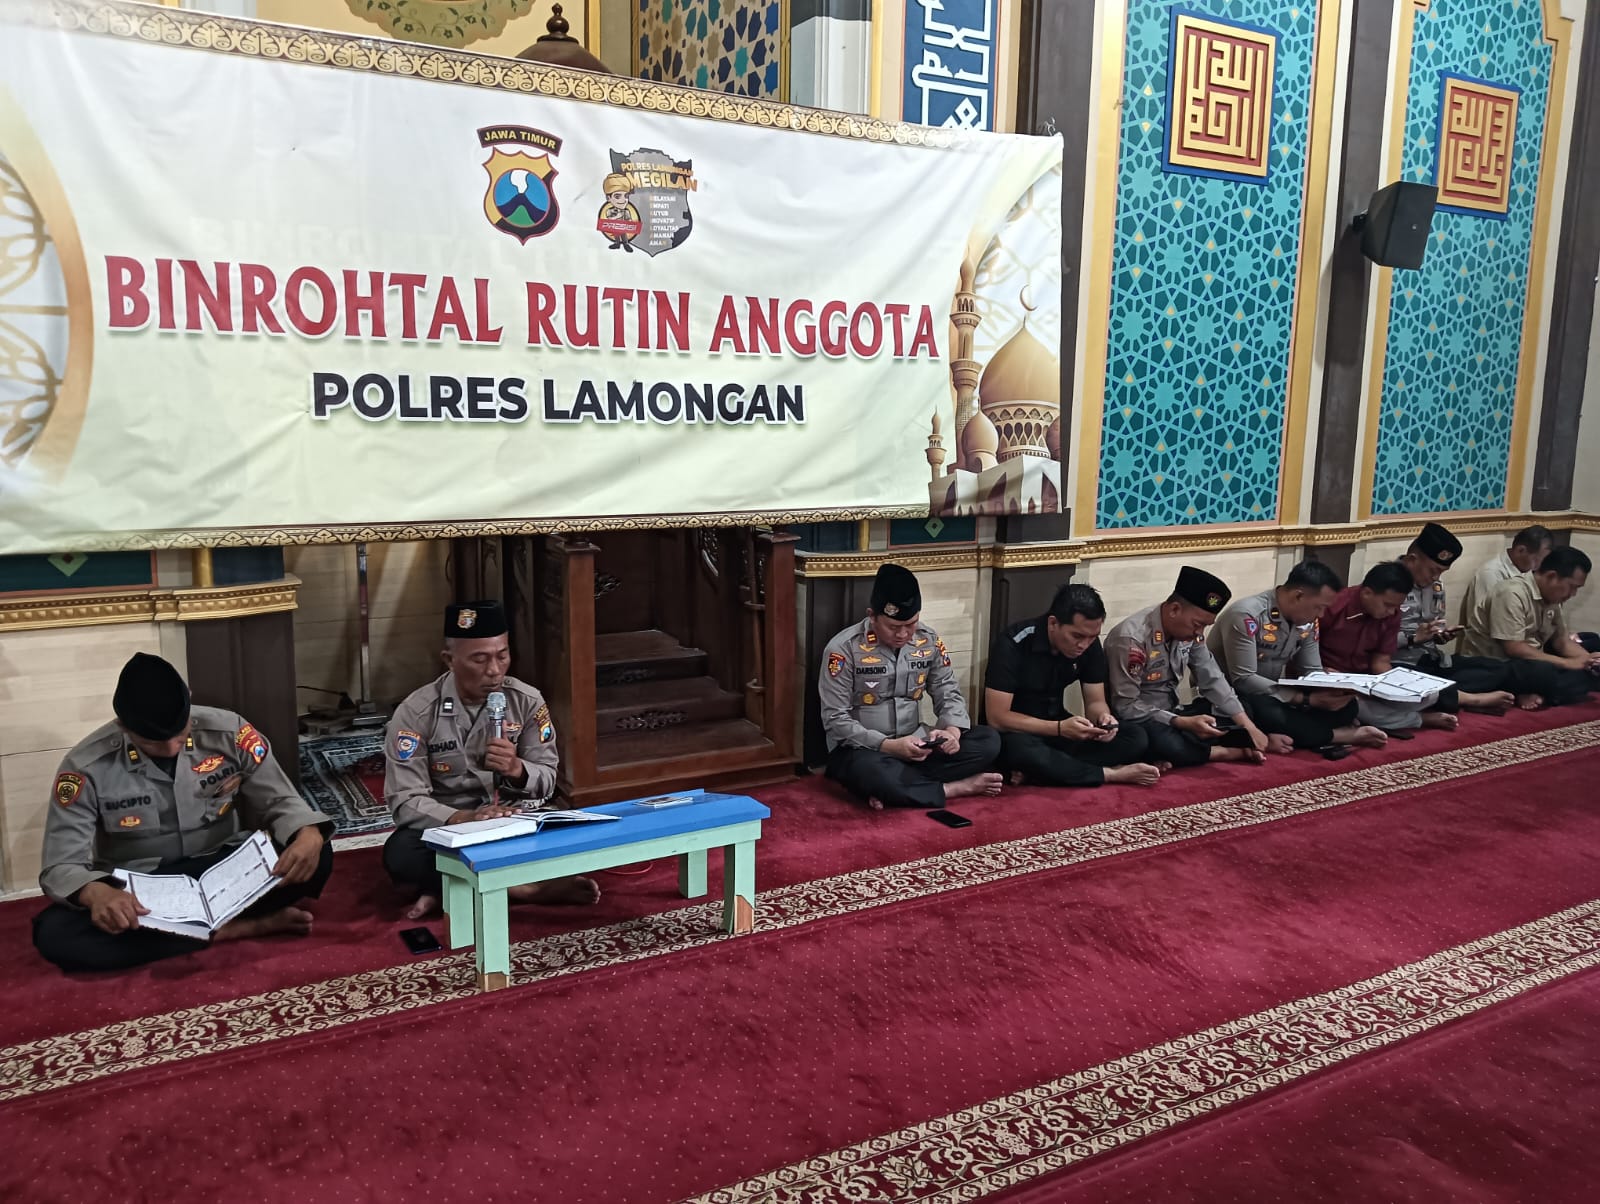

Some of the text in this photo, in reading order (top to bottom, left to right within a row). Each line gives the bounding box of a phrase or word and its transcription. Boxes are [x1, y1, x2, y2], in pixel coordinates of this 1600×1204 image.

[484, 130, 557, 149] JAWA TIMUR
[621, 162, 651, 171] POLRES
[626, 171, 698, 192] MEGILAN
[104, 255, 940, 358] BINROHTAL RUTIN ANGGOTA
[312, 372, 806, 422] POLRES LAMONGAN
[910, 660, 933, 670] POL
[199, 765, 235, 790] POLRI
